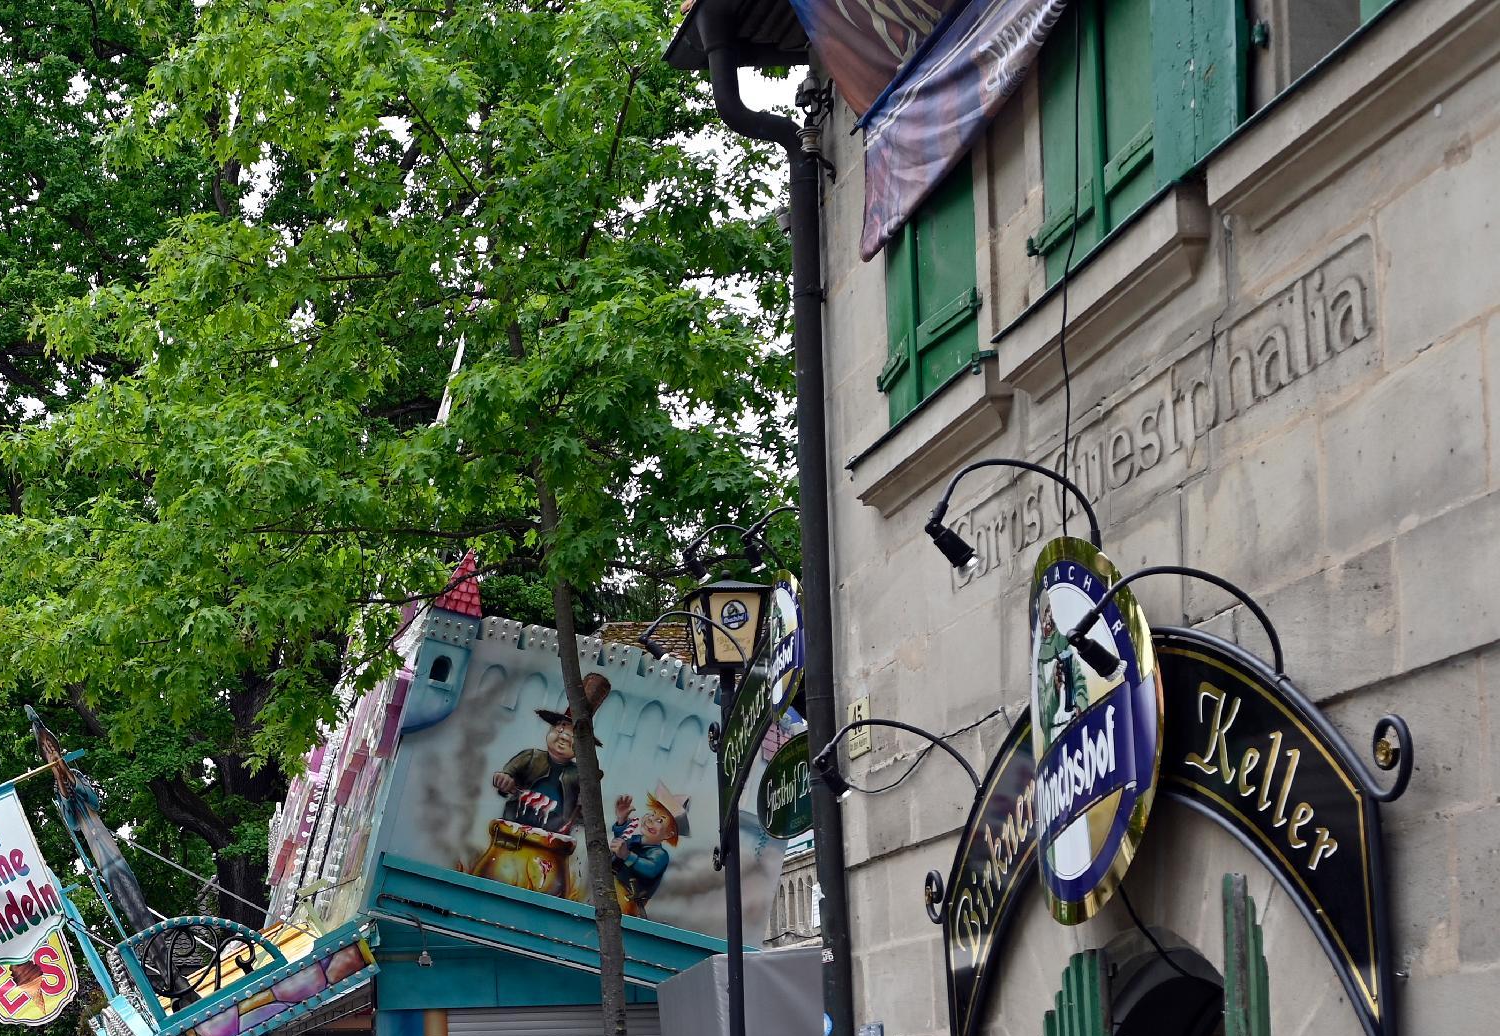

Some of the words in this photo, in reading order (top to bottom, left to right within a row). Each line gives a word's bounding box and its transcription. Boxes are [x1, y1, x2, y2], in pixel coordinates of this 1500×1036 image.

[852, 703, 863, 736] 45
[766, 763, 798, 829] Gasthof
[1184, 681, 1338, 871] Keller
